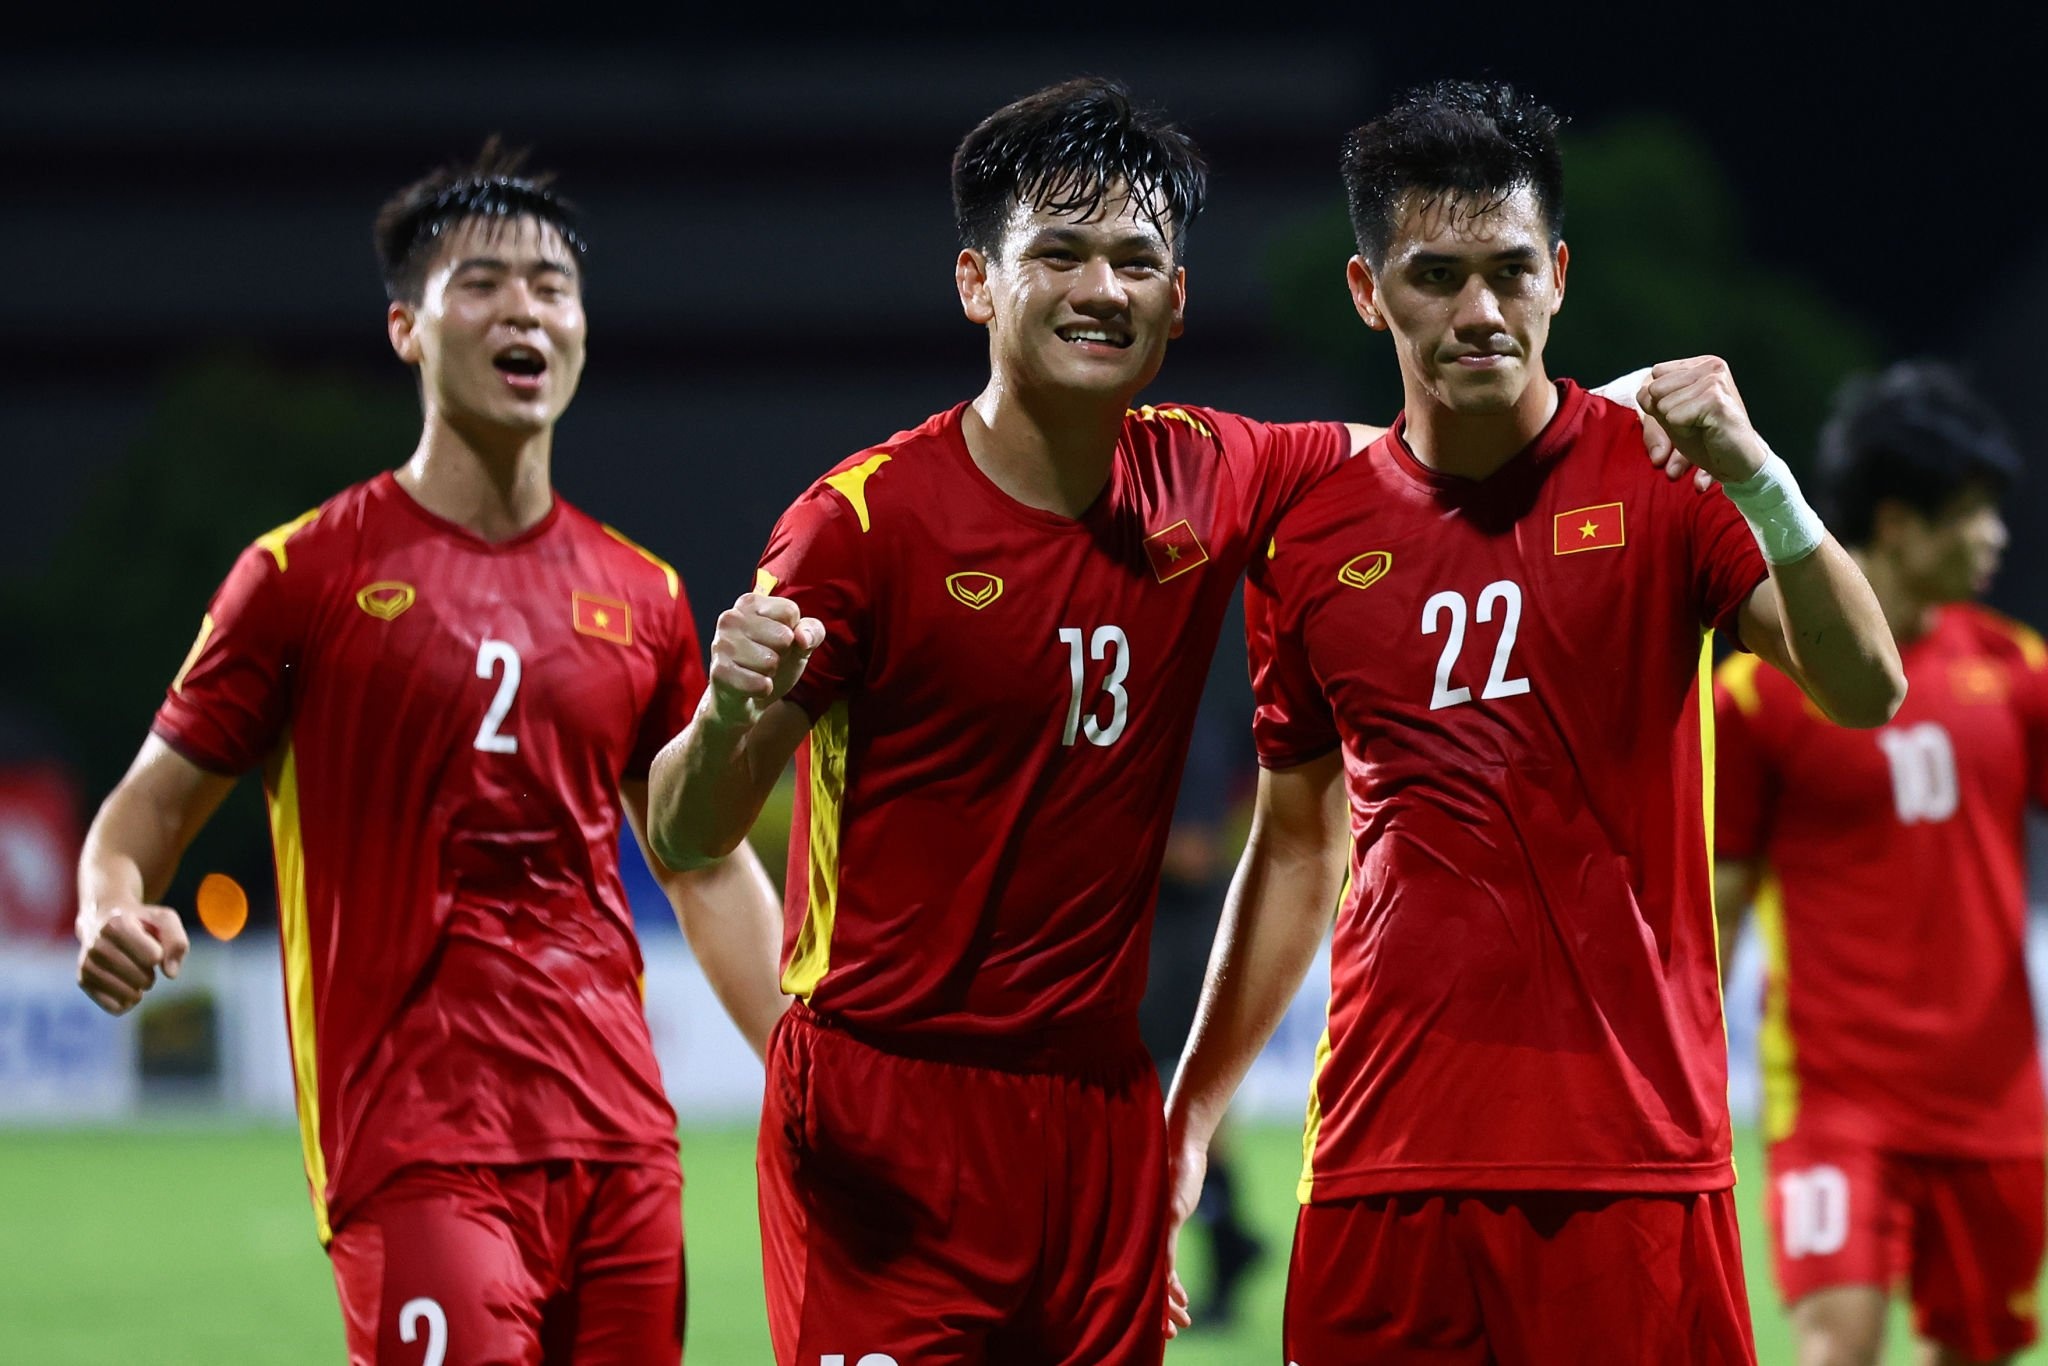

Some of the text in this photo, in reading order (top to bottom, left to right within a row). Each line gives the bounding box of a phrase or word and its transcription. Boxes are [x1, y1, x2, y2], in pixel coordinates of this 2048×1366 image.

[473, 638, 522, 755] 2
[1058, 624, 1130, 747] 13
[1421, 579, 1531, 711] 22
[1876, 722, 1960, 825] 10
[1780, 1164, 1850, 1259] 10
[398, 1296, 448, 1366] 2
